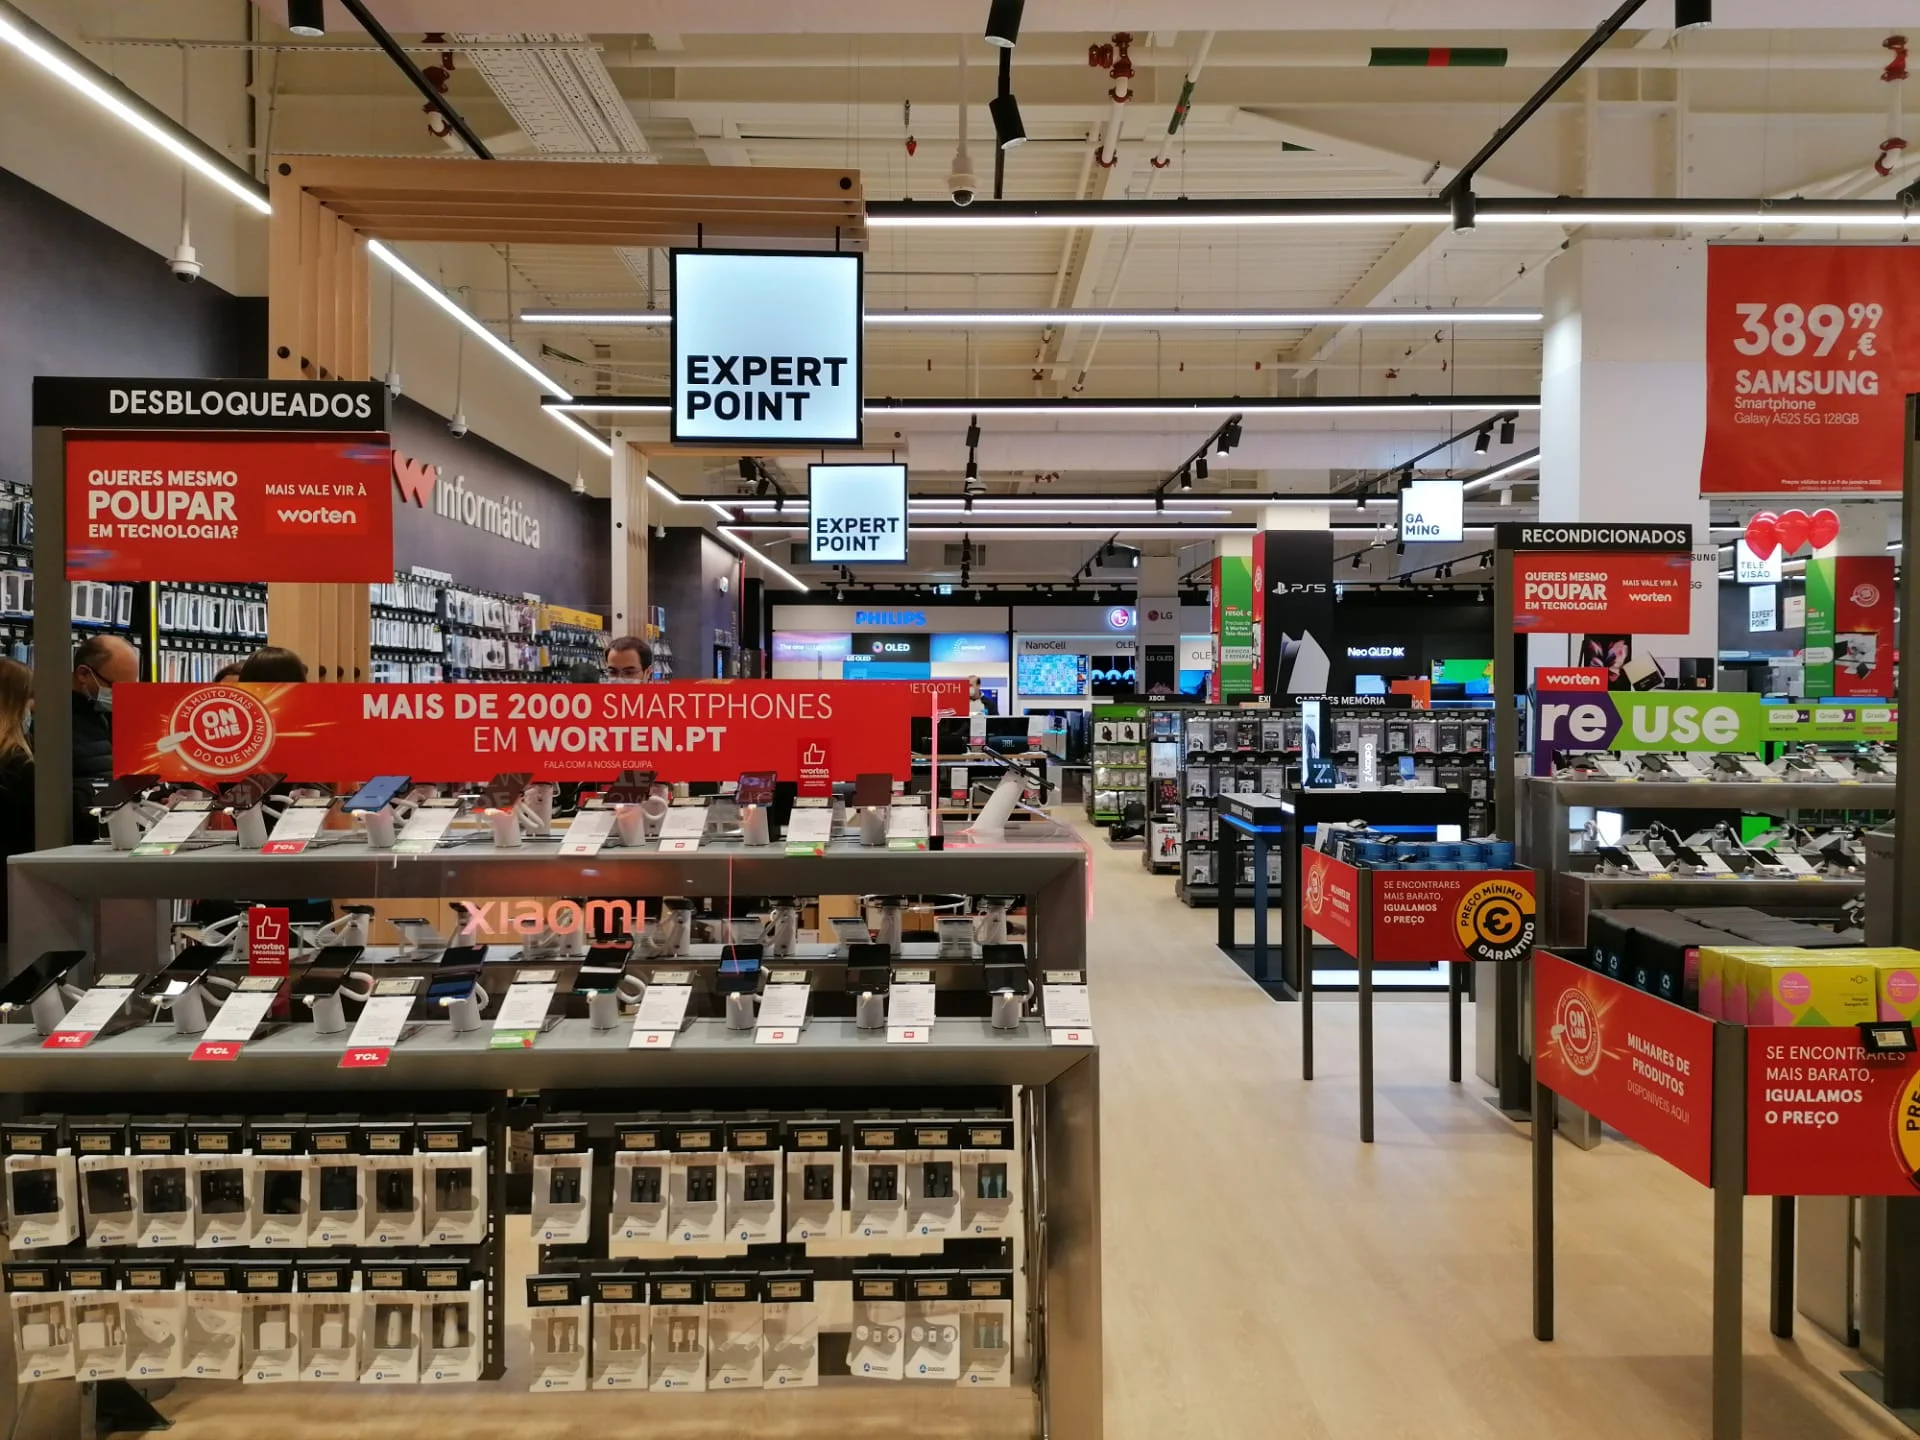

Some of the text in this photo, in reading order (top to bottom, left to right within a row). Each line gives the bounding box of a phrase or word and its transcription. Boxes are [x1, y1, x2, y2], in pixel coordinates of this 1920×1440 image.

[1733, 303, 1846, 357] 389
[1848, 303, 1883, 328] 99
[687, 355, 847, 386] EXPERT
[1735, 369, 1879, 395] SAMSUNG
[109, 389, 371, 418] DESBLOQUEADOS
[687, 390, 810, 421] POINT
[1735, 397, 1816, 411] Smartphone
[1734, 412, 1860, 426] Galaxy A52S 5G 128GB
[89, 470, 238, 488] QUERES MESMO
[265, 482, 367, 496] MAIS VALE VIR À
[88, 491, 238, 521] POUPAR
[436, 466, 540, 549] informática
[277, 507, 357, 524] worten
[1405, 513, 1424, 524] GA
[89, 525, 239, 539] EM TECNOLOGIA?
[816, 518, 899, 533] EXPERT
[1405, 524, 1440, 536] MING
[816, 536, 880, 552] POINT
[1522, 529, 1687, 545] RECONDICIONADOS
[1740, 561, 1766, 569] TELE
[1525, 572, 1608, 582] QUERES MESMO
[1291, 584, 1326, 593] PS5
[1525, 583, 1607, 601] POUPAR
[1629, 593, 1672, 603] worten
[1525, 602, 1608, 611] EM TECNOLOGIA?
[856, 611, 927, 627] PHILIPS
[1161, 612, 1173, 620] LG
[1751, 610, 1774, 619] EXPERT
[885, 643, 910, 652] OLED
[1025, 641, 1067, 650] NanoCell
[1347, 647, 1405, 657] Neo QLED 8K
[1546, 674, 1600, 685] worten
[191, 690, 226, 705] MUITO
[228, 690, 254, 710] MAIS
[363, 693, 833, 719] MAIS DE 2000 SMARTPHONES
[1341, 695, 1386, 705] MEMÓRIA
[202, 707, 238, 729] ON
[1540, 704, 1740, 745] re use
[204, 723, 241, 740] LINE
[193, 717, 265, 766] DO QUE IMAGINA
[474, 727, 727, 752] EM WORTEN.PT
[543, 760, 653, 769] FALA COM A NOSSA EQUIPA
[1364, 743, 1374, 774] Galaxy
[272, 843, 296, 851] TCL
[1384, 881, 1461, 889] SE ENCONTRARES
[1406, 893, 1444, 902] BARATO,
[1461, 882, 1523, 927] PREÇO MÍNIMO
[1384, 904, 1438, 912] IGUALAMOS
[461, 900, 646, 935] xiaomi
[1393, 916, 1425, 925] PREÇO
[253, 943, 285, 951] worten
[1478, 921, 1535, 961] GARANTIDO
[1569, 1010, 1585, 1028] ON
[1571, 1027, 1587, 1040] LINE
[205, 1047, 230, 1055] TCL
[1628, 1033, 1690, 1076] MILHARES DE
[1766, 1046, 1784, 1060] SE
[1633, 1057, 1684, 1097] PRODUTOS
[1766, 1068, 1875, 1083] MAIS BARATO,
[1627, 1080, 1690, 1125] DISPONÍVEIS AQUI
[1766, 1089, 1863, 1103] IGUALAMOS
[1766, 1111, 1839, 1128] O PREÇO
